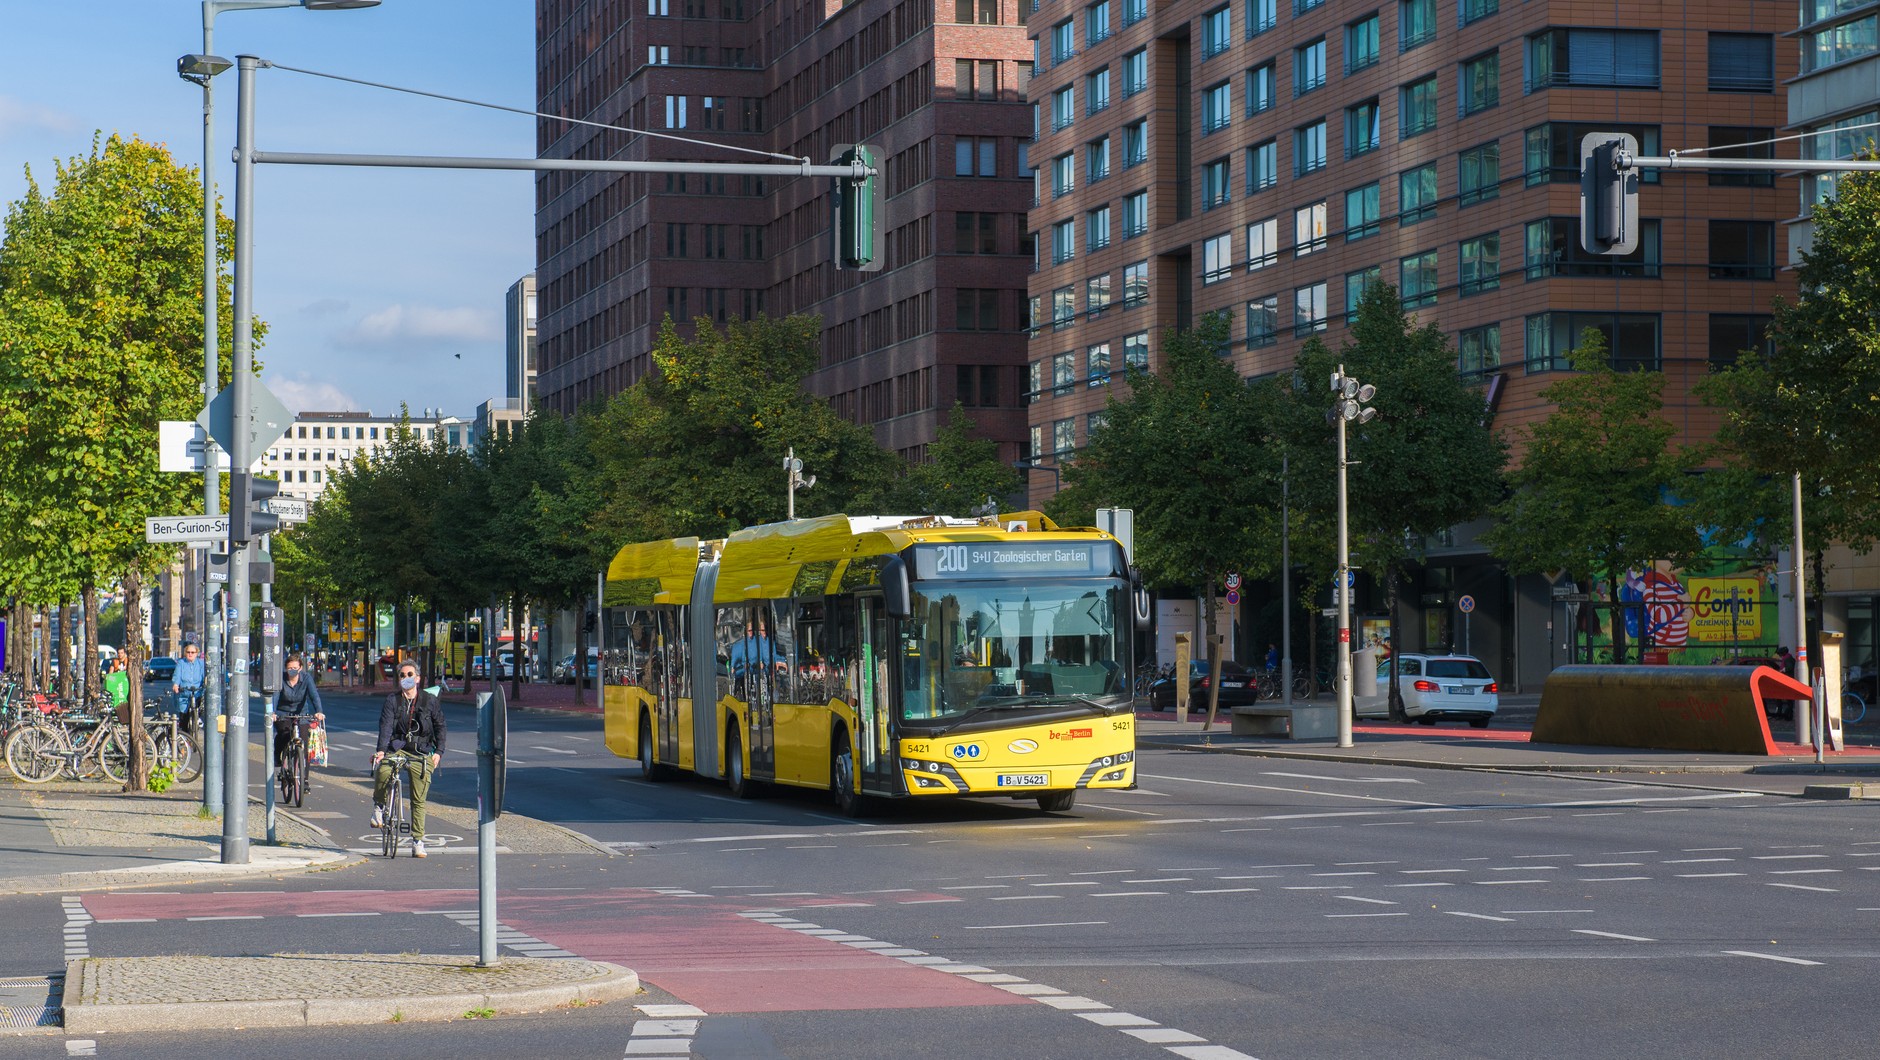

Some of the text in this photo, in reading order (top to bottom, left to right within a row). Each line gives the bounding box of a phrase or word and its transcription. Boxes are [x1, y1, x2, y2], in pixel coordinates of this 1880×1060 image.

[936, 545, 1087, 572] 200 S+U Zoologischer Garten
[1227, 575, 1238, 585] 30
[1695, 586, 1753, 617] Conni
[263, 609, 276, 619] R 4
[1112, 721, 1130, 731] 5421
[1049, 729, 1061, 740] be
[907, 744, 930, 753] 5421
[1006, 775, 1044, 785] B V 5421
